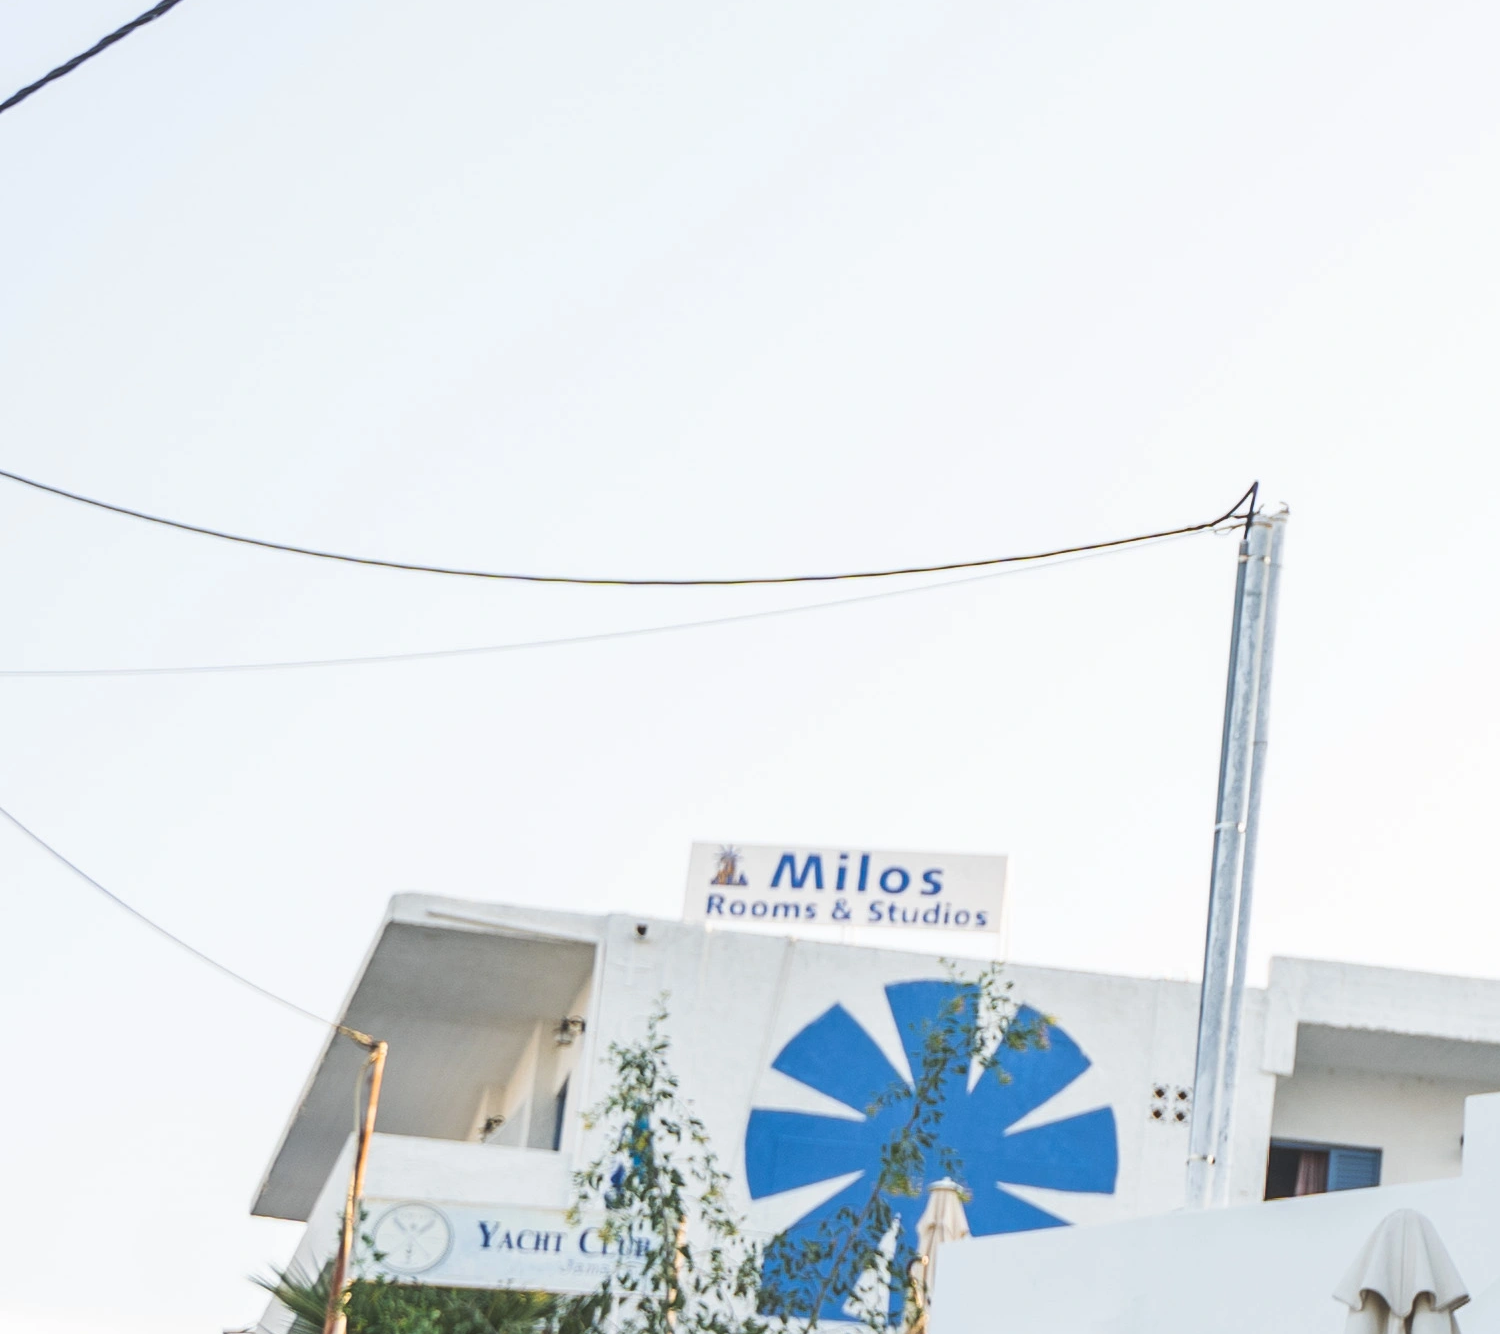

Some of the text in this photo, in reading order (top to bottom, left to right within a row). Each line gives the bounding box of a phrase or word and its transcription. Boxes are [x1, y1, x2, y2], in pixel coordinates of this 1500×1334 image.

[770, 852, 943, 895] Milos
[706, 894, 988, 926] Rooms & Studios
